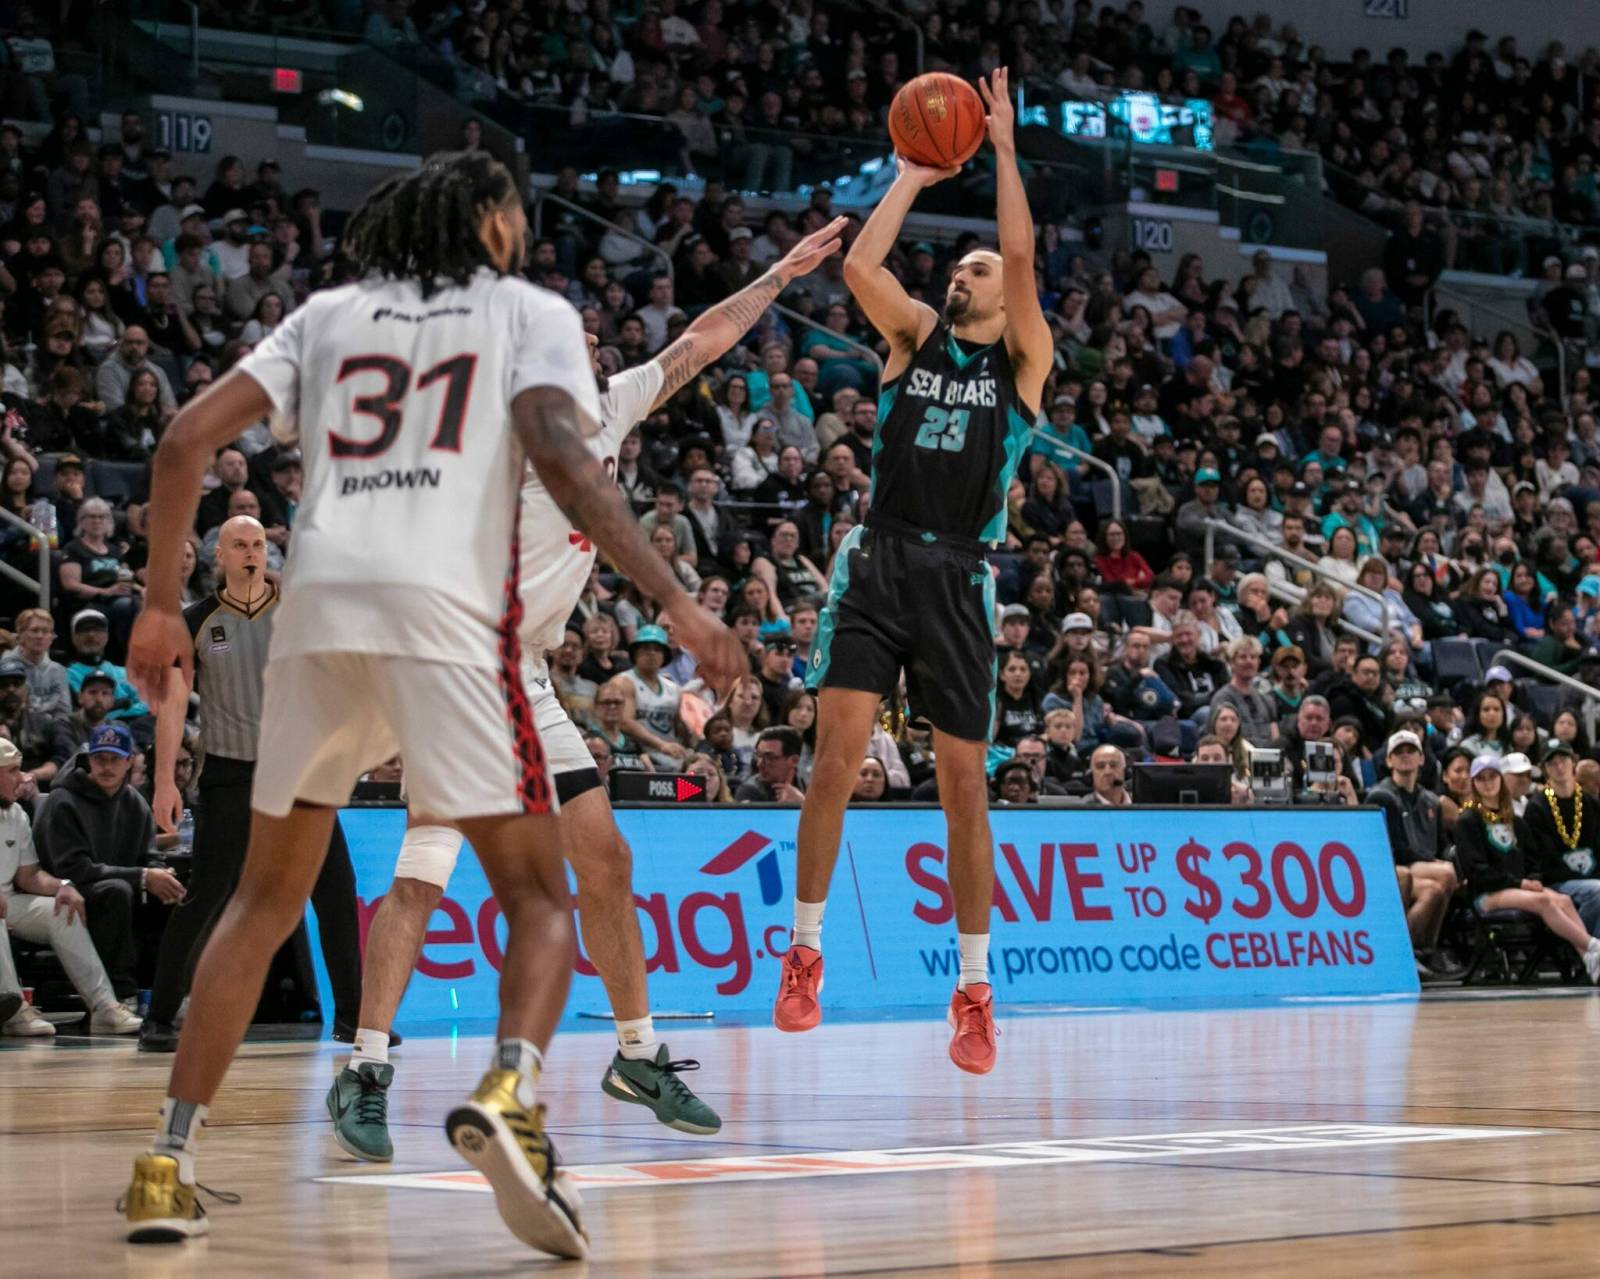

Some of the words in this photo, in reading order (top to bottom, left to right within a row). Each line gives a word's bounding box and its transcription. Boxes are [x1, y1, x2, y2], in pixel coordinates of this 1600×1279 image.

[160, 115, 211, 149] 119
[1134, 220, 1172, 250] 120
[906, 367, 943, 401] SEA
[328, 353, 478, 460] 31
[913, 406, 970, 453] 23
[341, 467, 441, 497] BROWN
[649, 780, 676, 797] POSS.
[1116, 842, 1157, 874] UP
[1175, 836, 1367, 926] $300
[1124, 886, 1168, 918] TO
[1002, 946, 1114, 985] promo
[1120, 933, 1202, 972] code
[1206, 930, 1375, 970] CEBLFANS
